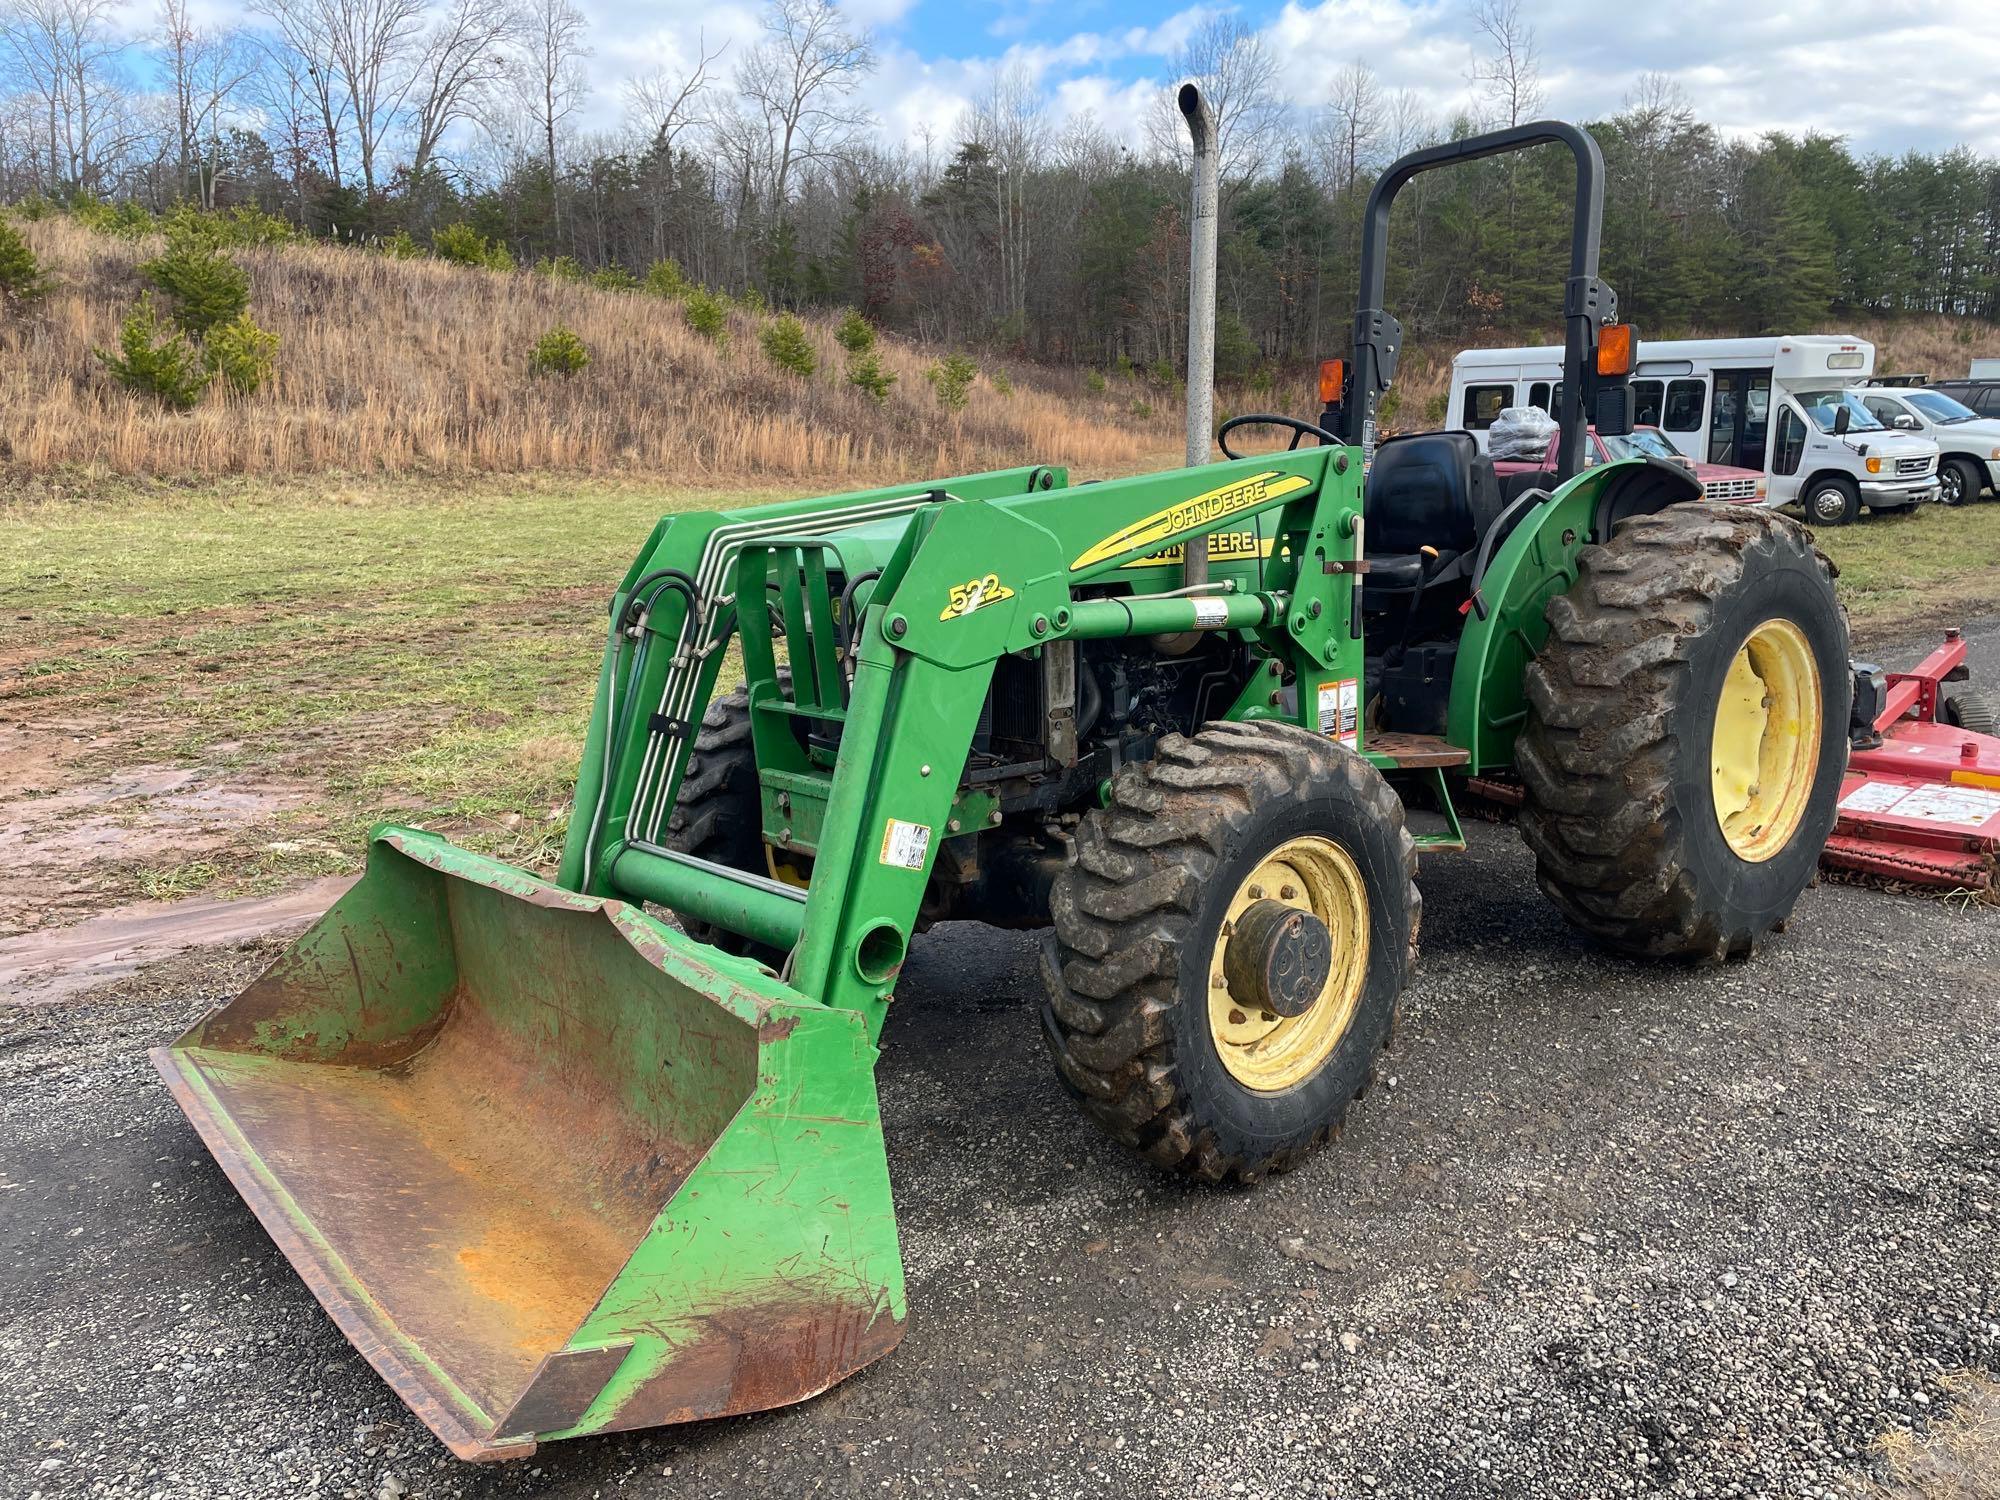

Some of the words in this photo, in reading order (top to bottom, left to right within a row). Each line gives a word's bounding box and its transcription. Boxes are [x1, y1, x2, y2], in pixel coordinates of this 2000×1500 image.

[1162, 503, 1209, 533] JOHN
[1208, 481, 1266, 516] DEERE
[1208, 531, 1254, 554] EERE
[949, 573, 1002, 614] 522
